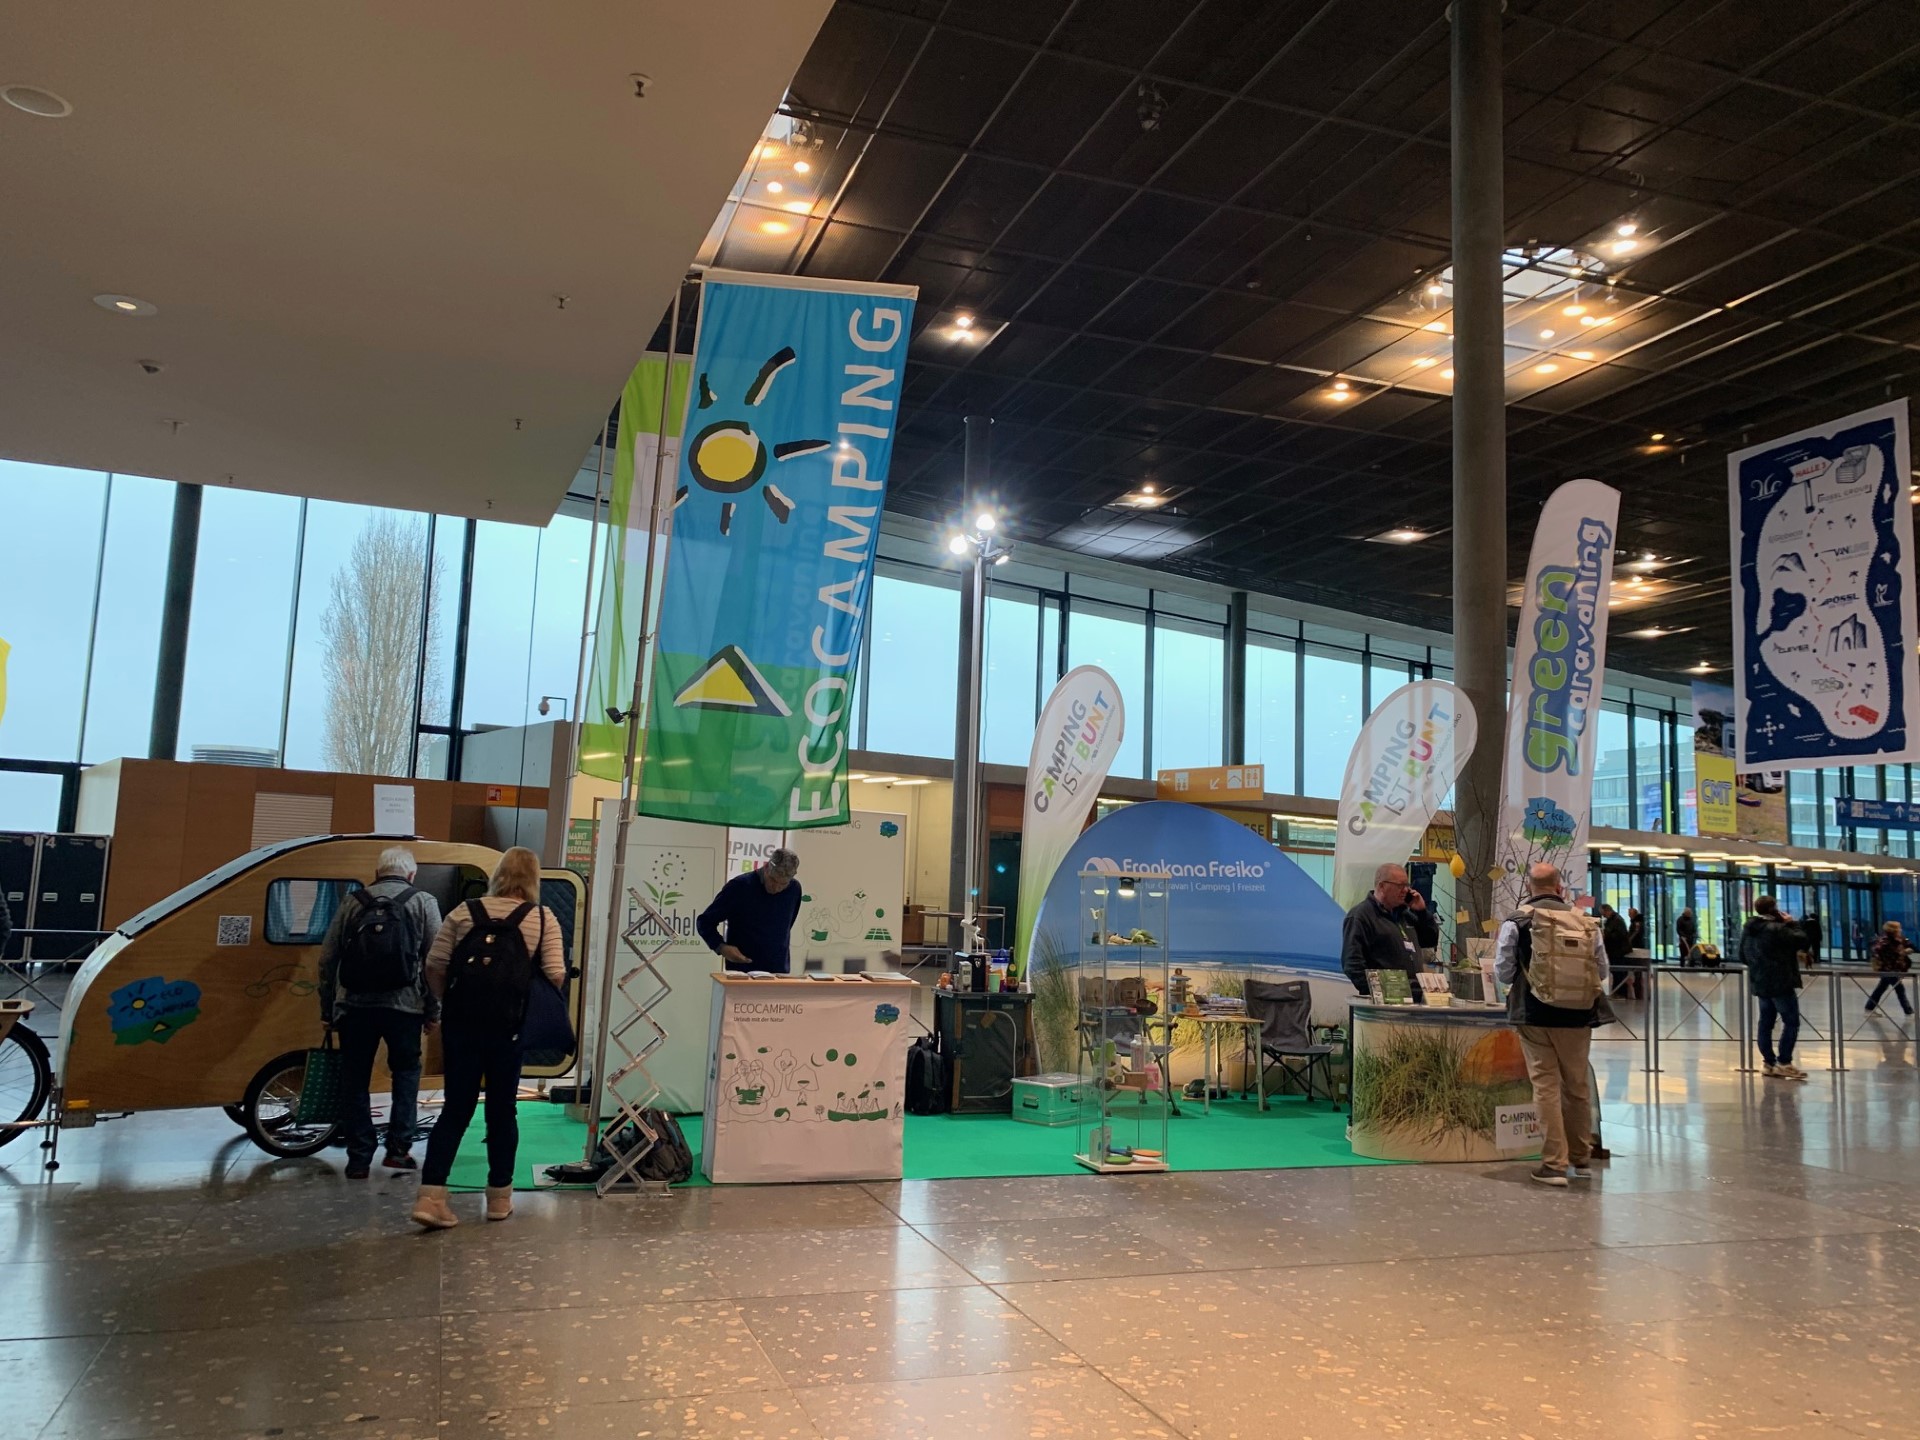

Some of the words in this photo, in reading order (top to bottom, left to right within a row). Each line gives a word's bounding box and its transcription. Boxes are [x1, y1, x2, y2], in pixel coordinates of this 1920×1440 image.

[789, 306, 902, 823] ECOCAMPING
[1526, 570, 1577, 770] green
[1566, 523, 1610, 733] caravaning
[1034, 699, 1087, 813] CAMPING
[1062, 757, 1082, 796] IST
[1075, 690, 1109, 761] BUNT
[1348, 719, 1417, 837] CAMPING
[1384, 777, 1412, 816] IST
[1403, 702, 1450, 779] BUNT
[1701, 778, 1733, 806] CMT
[45, 836, 57, 849] 4
[728, 841, 776, 858] PING
[1158, 881, 1189, 890] Cravan
[1195, 881, 1231, 893] Camping
[733, 1003, 804, 1015] ECOCAMPING
